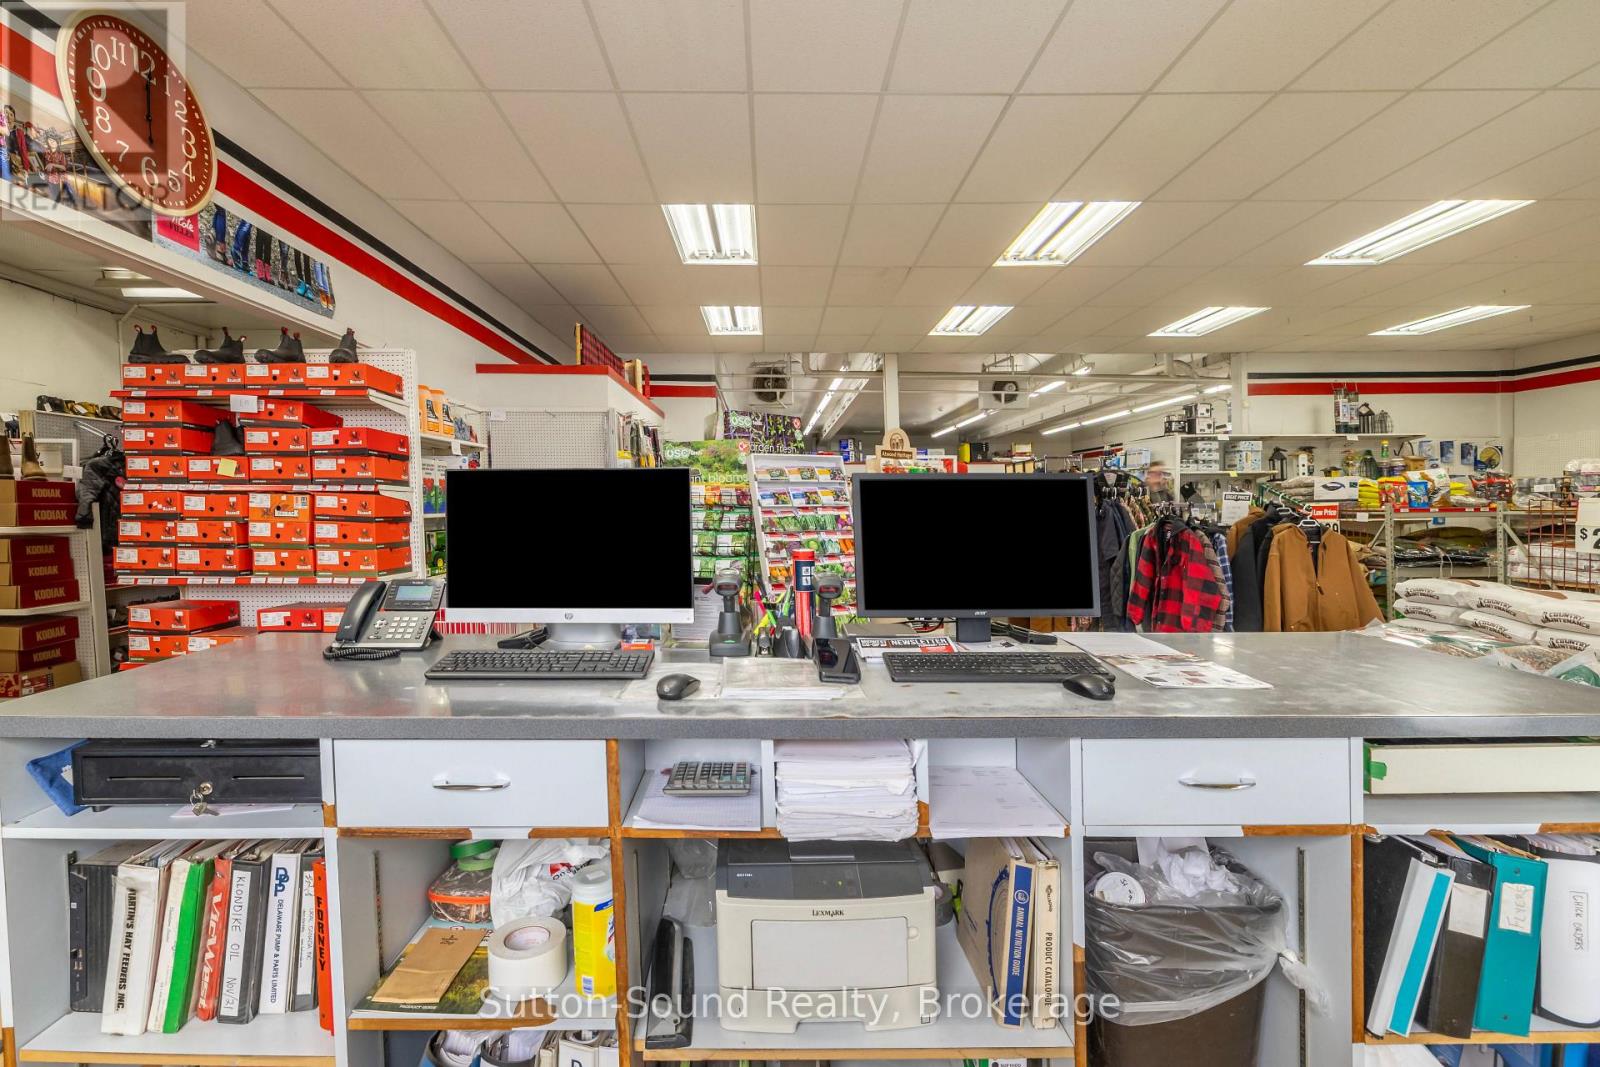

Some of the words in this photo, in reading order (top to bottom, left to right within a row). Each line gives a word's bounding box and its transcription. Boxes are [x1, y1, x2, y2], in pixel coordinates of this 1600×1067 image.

[90, 39, 111, 71] 10
[111, 37, 126, 66] 11
[130, 41, 157, 86] 12
[86, 66, 107, 102] 9
[164, 75, 171, 97] 1
[96, 106, 112, 134] 8
[175, 100, 188, 123] 2
[116, 140, 129, 163] 7
[182, 128, 196, 160] 3
[141, 156, 159, 189] 6
[168, 169, 181, 192] 5
[182, 161, 196, 183] 4
[32, 488, 61, 498] KODIAK
[34, 510, 68, 520] KODIAK
[1323, 508, 1337, 516] Price
[1580, 528, 1588, 540] $
[26, 545, 55, 555] KODIAK
[28, 566, 58, 577] KODIAK
[34, 587, 66, 600] KODIAK
[36, 626, 67, 641] KODIAK
[890, 638, 947, 647] NEWSLETTER
[33, 647, 62, 662] KODIAK
[126, 887, 137, 930] MARTIN'S
[232, 876, 247, 932] KLONDIKE
[1572, 894, 1583, 919] CHICK
[275, 899, 284, 934] DELAWARE
[1015, 906, 1025, 928] ANIMAL
[123, 931, 134, 952] HAY
[315, 896, 327, 971] FORNEY
[1013, 929, 1023, 959] NUTRITION
[1573, 921, 1584, 951] ORDERS
[229, 943, 241, 961] OIL
[1045, 932, 1053, 965] PRODUCT
[118, 953, 131, 991] FEEDERS
[272, 960, 280, 978] PARTS
[1011, 959, 1021, 977] GUIDE
[270, 979, 279, 1004] LIMITED
[1044, 966, 1052, 1007] CATALOGUE
[115, 993, 126, 1011] INC.
